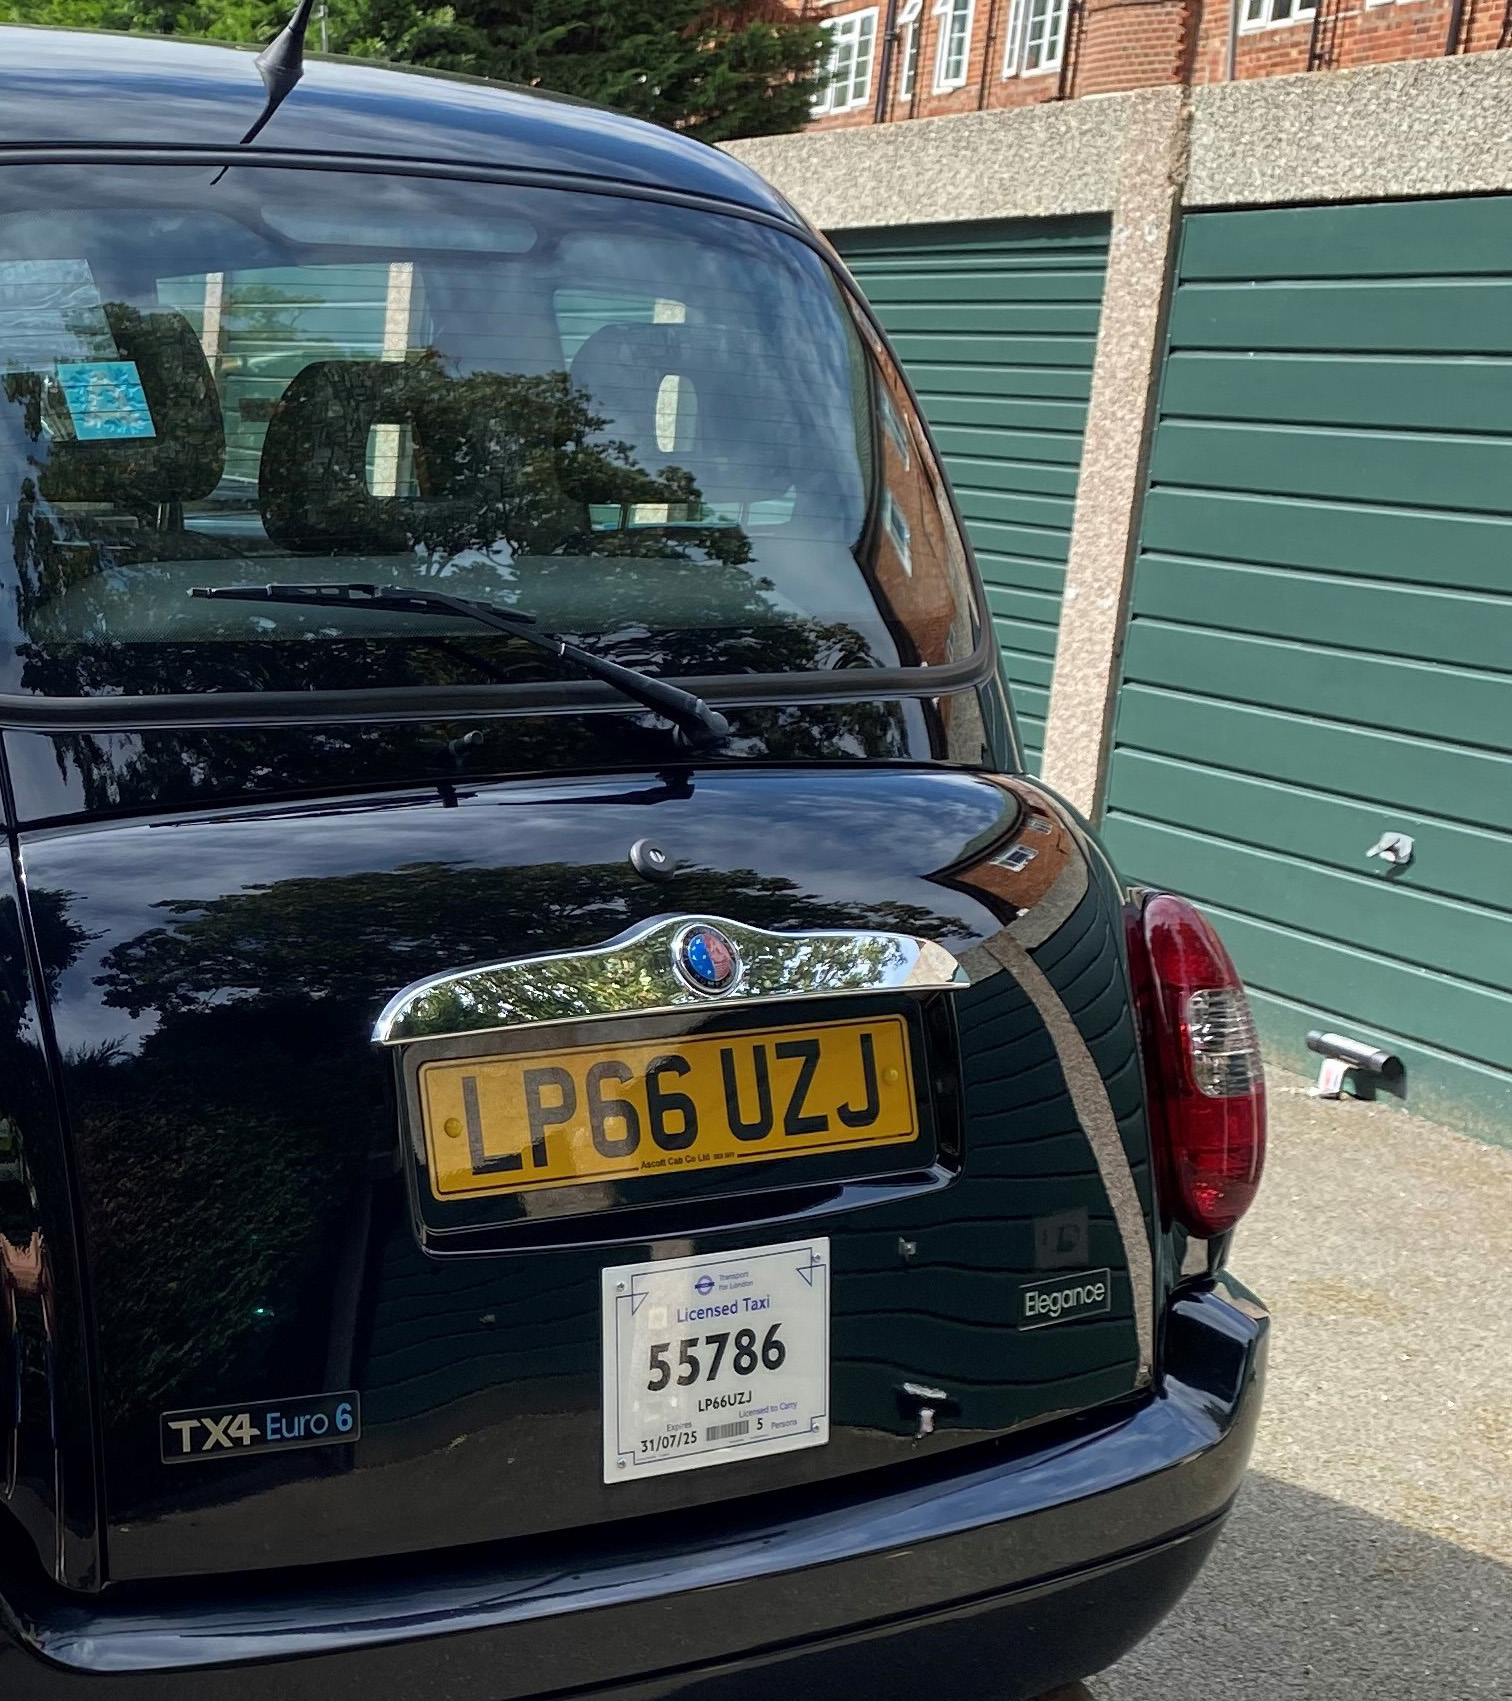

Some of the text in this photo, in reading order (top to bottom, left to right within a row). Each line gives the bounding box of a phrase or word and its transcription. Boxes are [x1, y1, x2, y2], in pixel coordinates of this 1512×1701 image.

[462, 1033, 881, 1176] LP66 UZJ
[668, 1156, 683, 1165] Cab
[685, 1155, 696, 1164] Co
[698, 1153, 710, 1162] Ltd
[719, 1271, 749, 1282] Transport
[729, 1280, 753, 1290] London
[677, 1294, 770, 1323] Licensed Taxi
[1024, 1282, 1105, 1318] Elegance
[647, 1323, 787, 1392] 55786
[698, 1391, 753, 1412] LP66UZJ
[738, 1401, 798, 1418] Licensed to Carry
[167, 1402, 353, 1453] TX4 Euro 6
[666, 1420, 692, 1432] Expires
[756, 1418, 798, 1431] 5 Persons
[640, 1431, 698, 1453] 31/07/25
